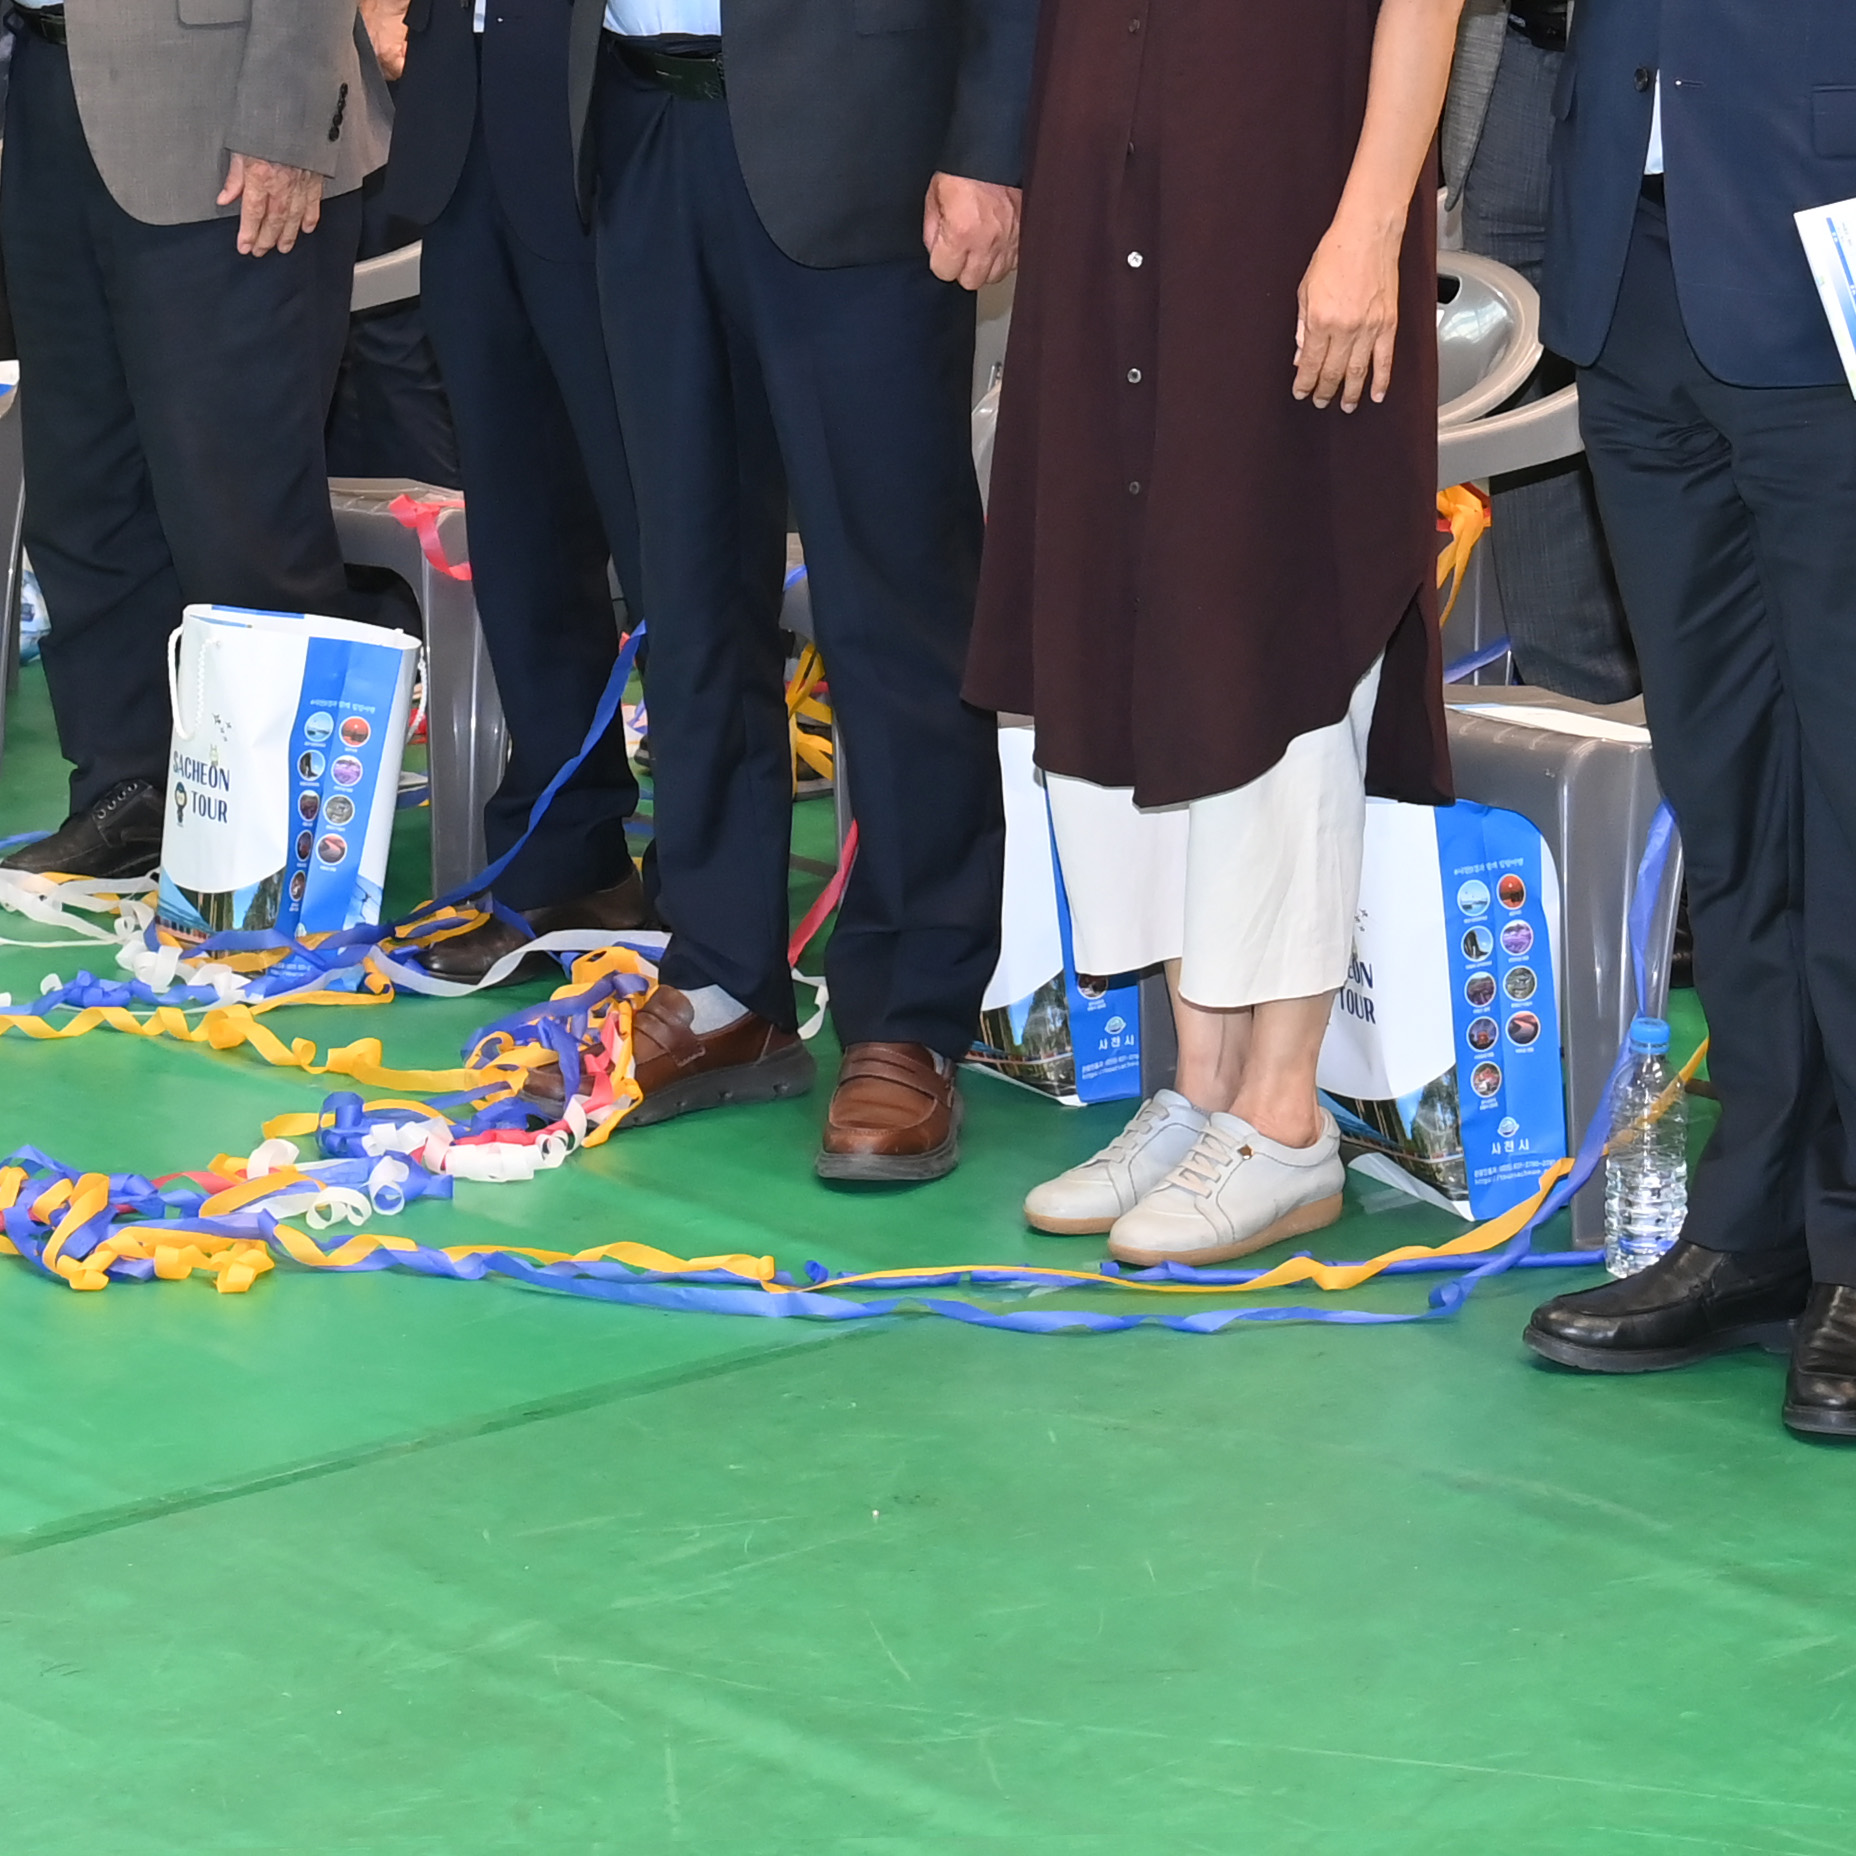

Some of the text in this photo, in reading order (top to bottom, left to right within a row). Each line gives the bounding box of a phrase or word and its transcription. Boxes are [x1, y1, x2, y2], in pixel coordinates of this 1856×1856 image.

[172, 750, 231, 792] SACHEON
[190, 790, 228, 824] TOUR
[1339, 988, 1376, 1025] TOUR
